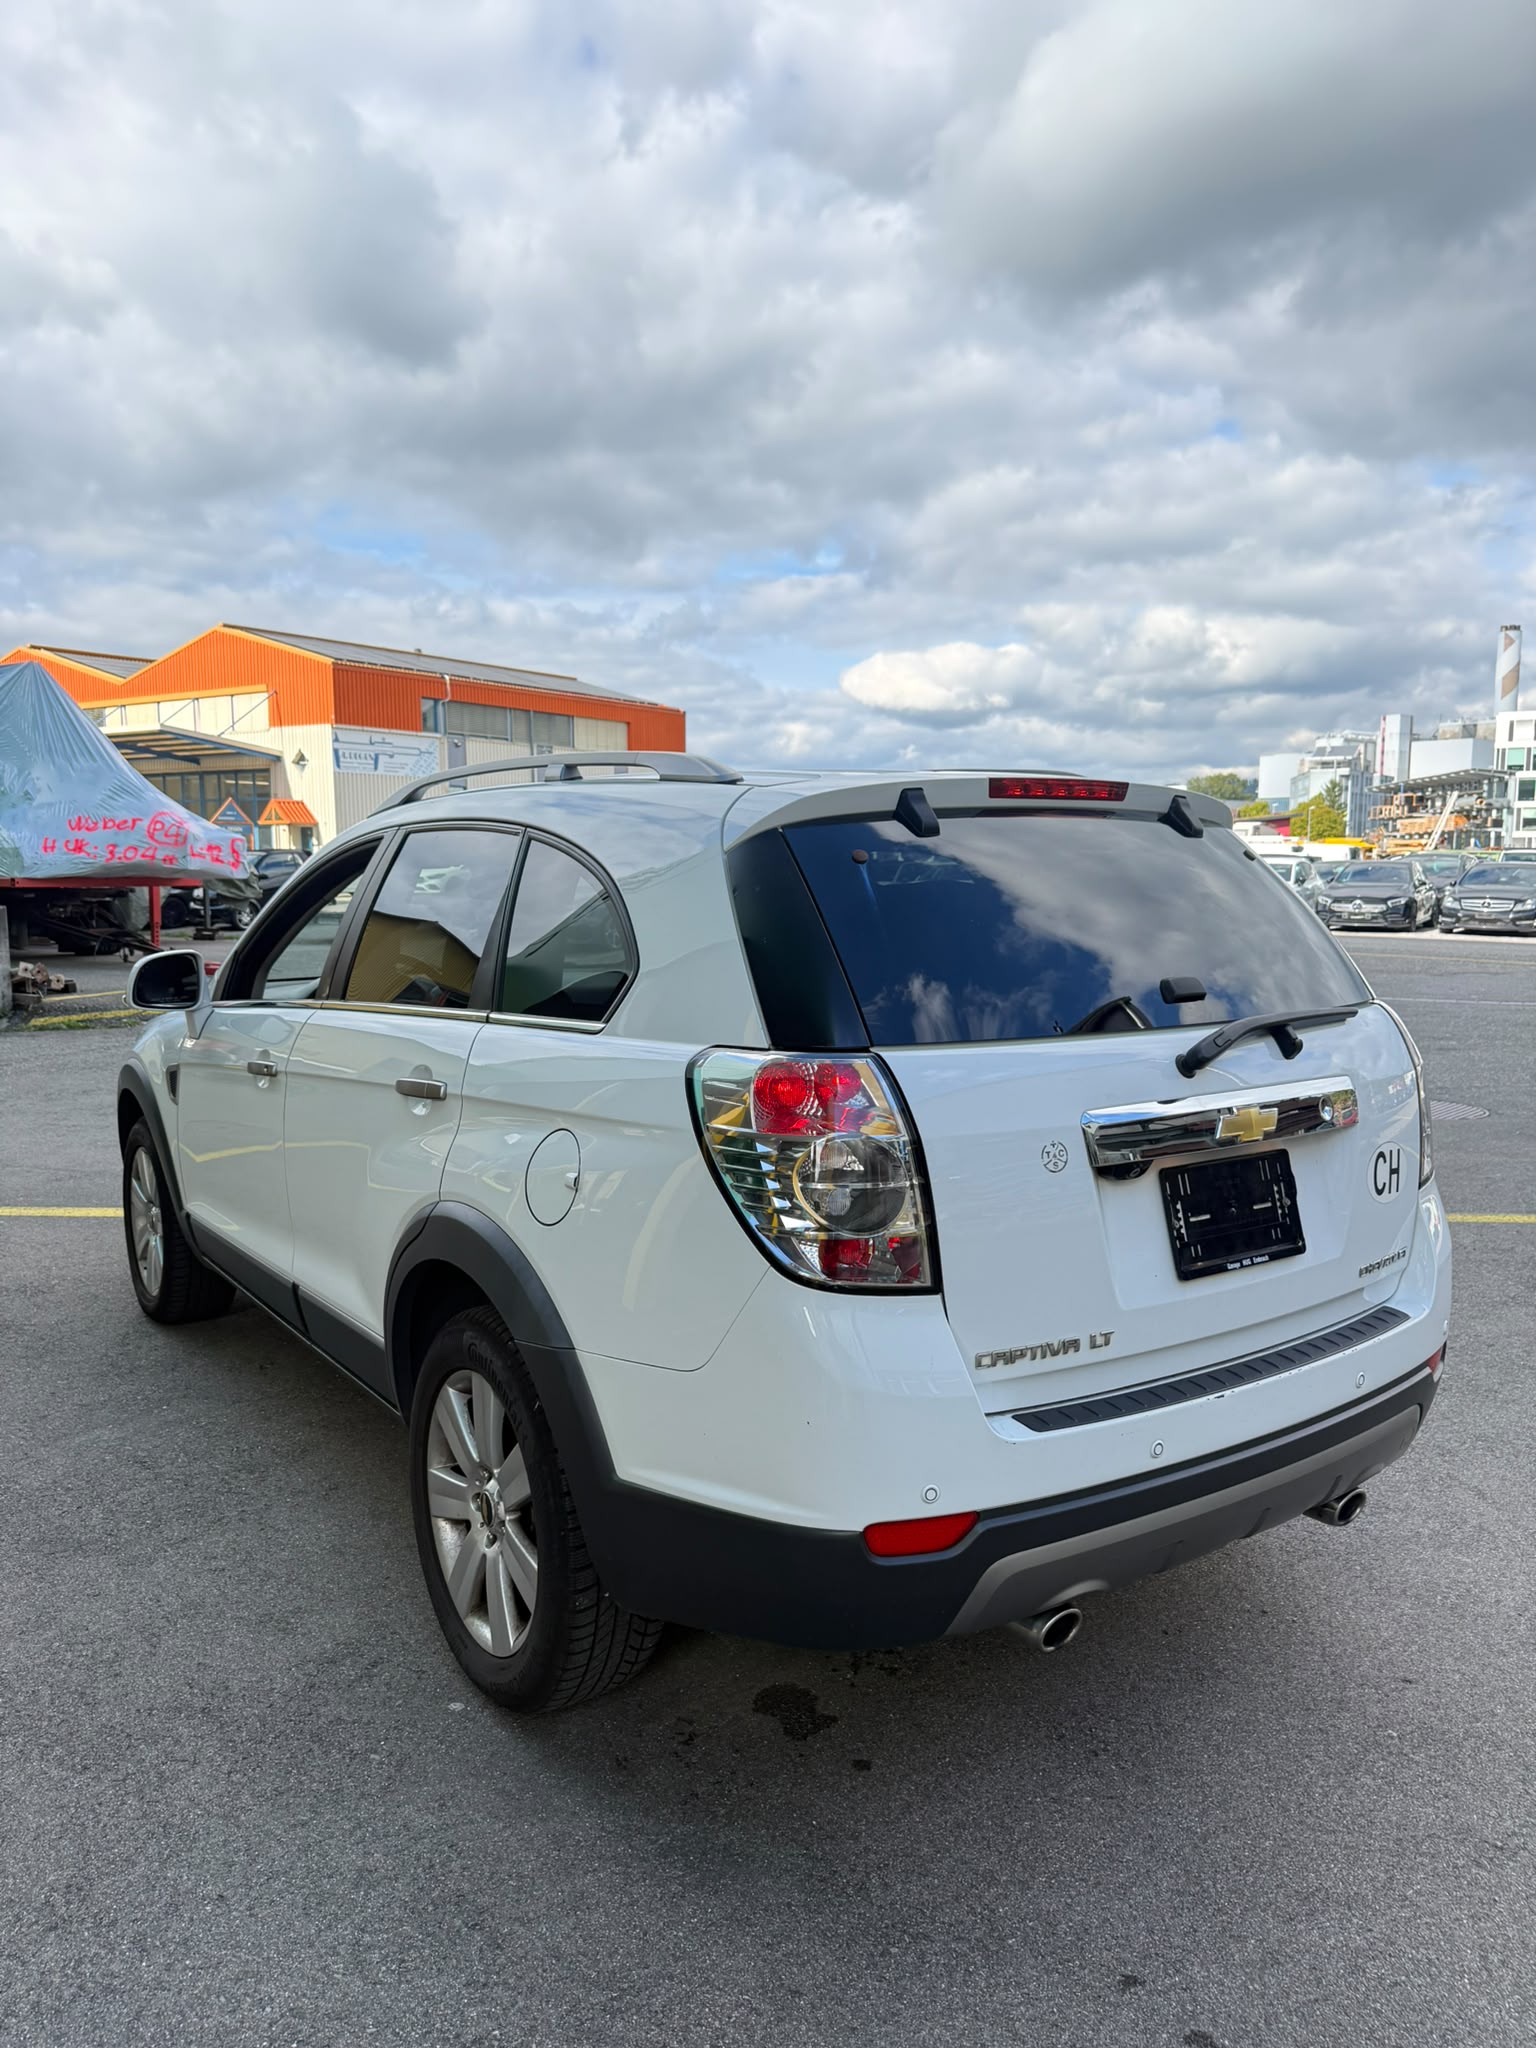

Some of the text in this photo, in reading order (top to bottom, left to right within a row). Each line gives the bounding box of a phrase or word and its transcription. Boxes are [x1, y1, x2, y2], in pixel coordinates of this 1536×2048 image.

[67, 815, 145, 832] Weber
[1373, 1148, 1401, 1196] CH
[974, 1329, 1115, 1370] CAPTIVA LT
